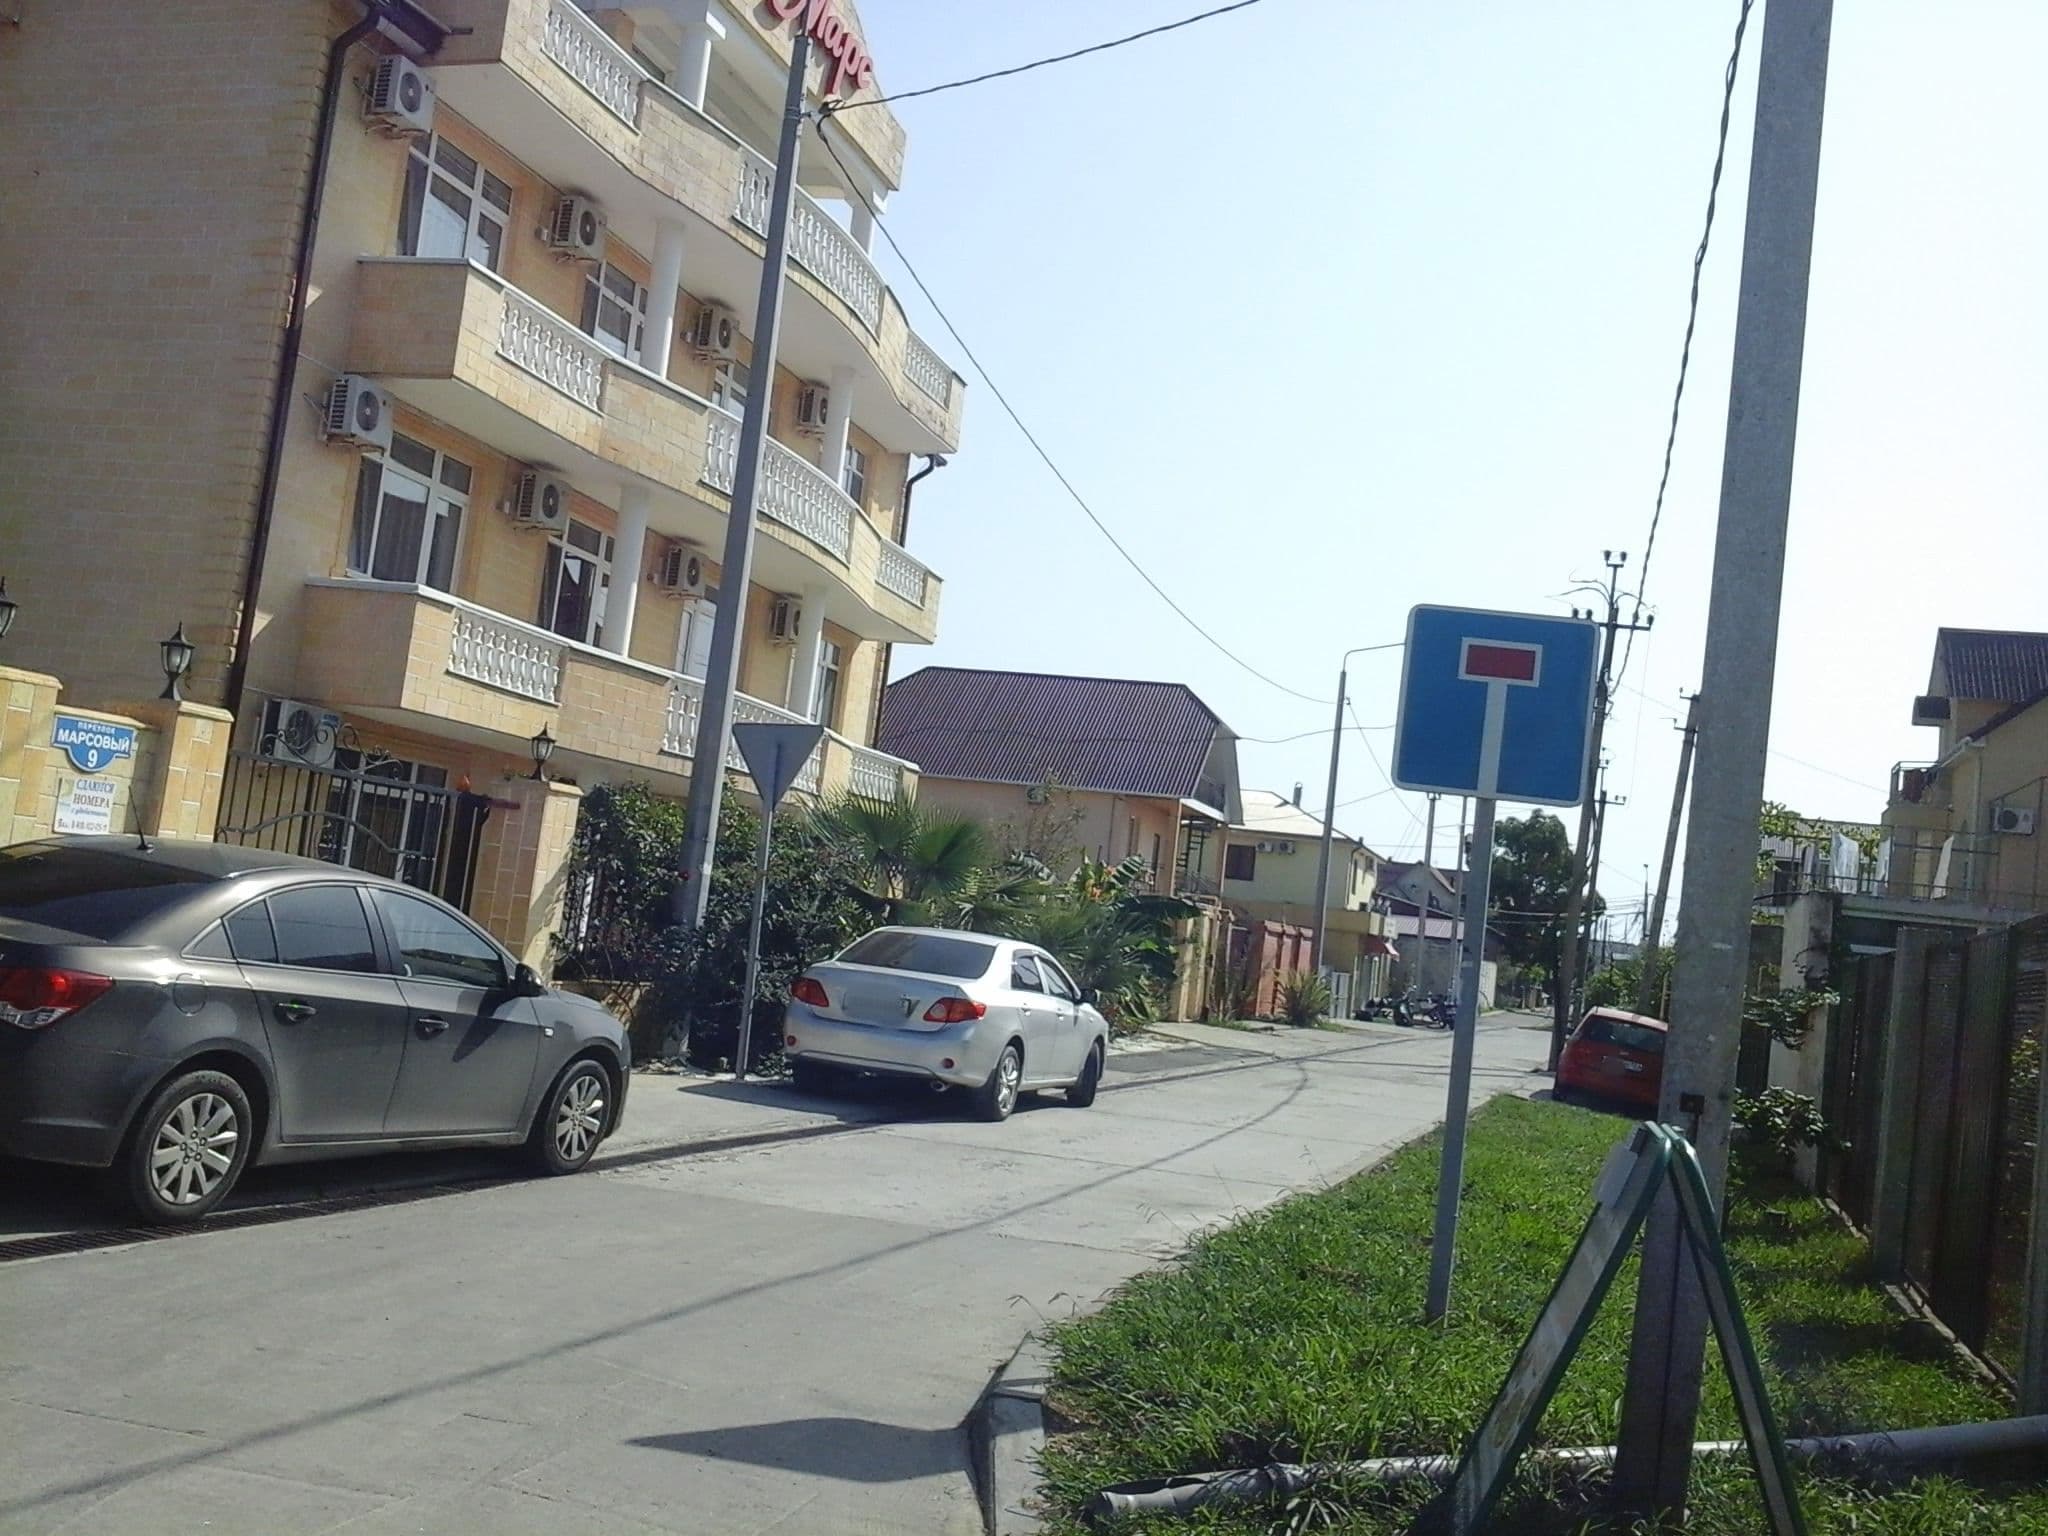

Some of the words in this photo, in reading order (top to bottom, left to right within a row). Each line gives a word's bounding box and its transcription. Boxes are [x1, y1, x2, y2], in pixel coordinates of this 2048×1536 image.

[58, 728, 130, 752] МАРСОВЫЙ
[87, 749, 98, 768] 9
[73, 793, 109, 808] НОМЕРА
